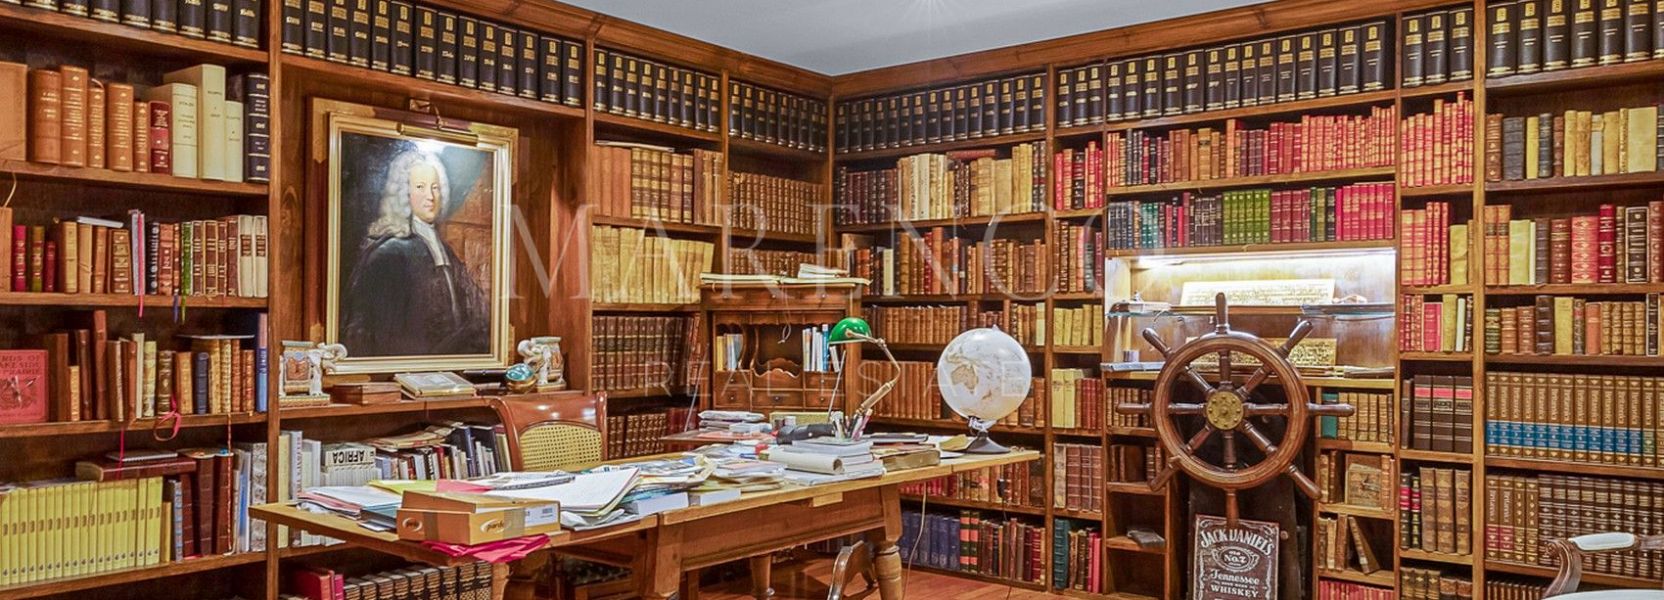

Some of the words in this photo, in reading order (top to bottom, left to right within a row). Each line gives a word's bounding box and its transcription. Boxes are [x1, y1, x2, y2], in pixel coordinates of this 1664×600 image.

[332, 450, 366, 464] AFRICA
[1200, 528, 1228, 548] JACK
[1228, 528, 1275, 556] DANIEL'S
[1211, 569, 1260, 585] Tennessee
[1210, 584, 1259, 598] WHISKEY
